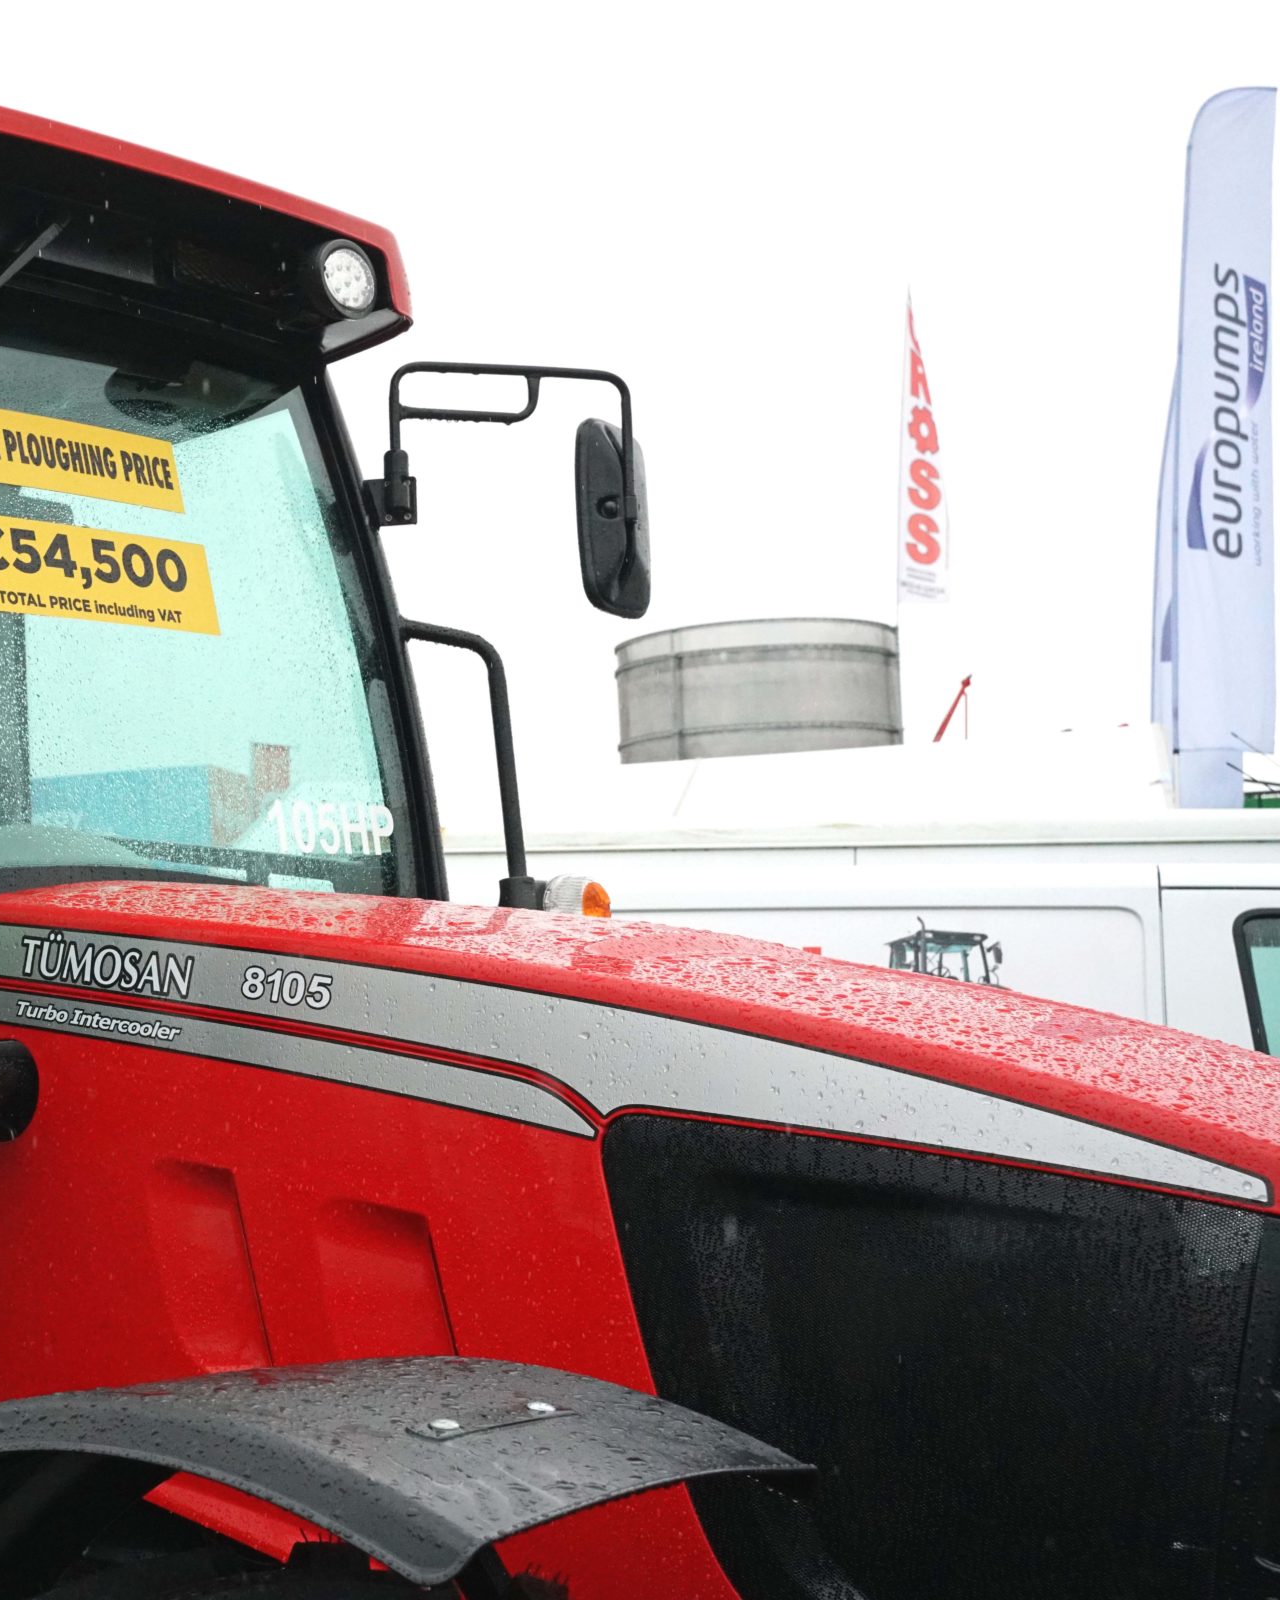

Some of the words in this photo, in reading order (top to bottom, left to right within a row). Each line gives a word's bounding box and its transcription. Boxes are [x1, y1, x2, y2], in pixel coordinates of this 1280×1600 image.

[1249, 287, 1266, 374] ireland
[905, 306, 942, 566] ROSS
[1212, 262, 1249, 560] europumps
[3, 429, 117, 480] PLOUGHING
[120, 450, 174, 491] PRICE
[49, 595, 92, 613] PRICE
[94, 600, 156, 623] including
[157, 608, 183, 624] VAT
[268, 799, 395, 856] 105HP
[22, 930, 195, 999] TÜMOSAN
[240, 965, 334, 1010] 8105
[16, 1000, 68, 1023] Turbo
[69, 1009, 182, 1041] Intercooler
